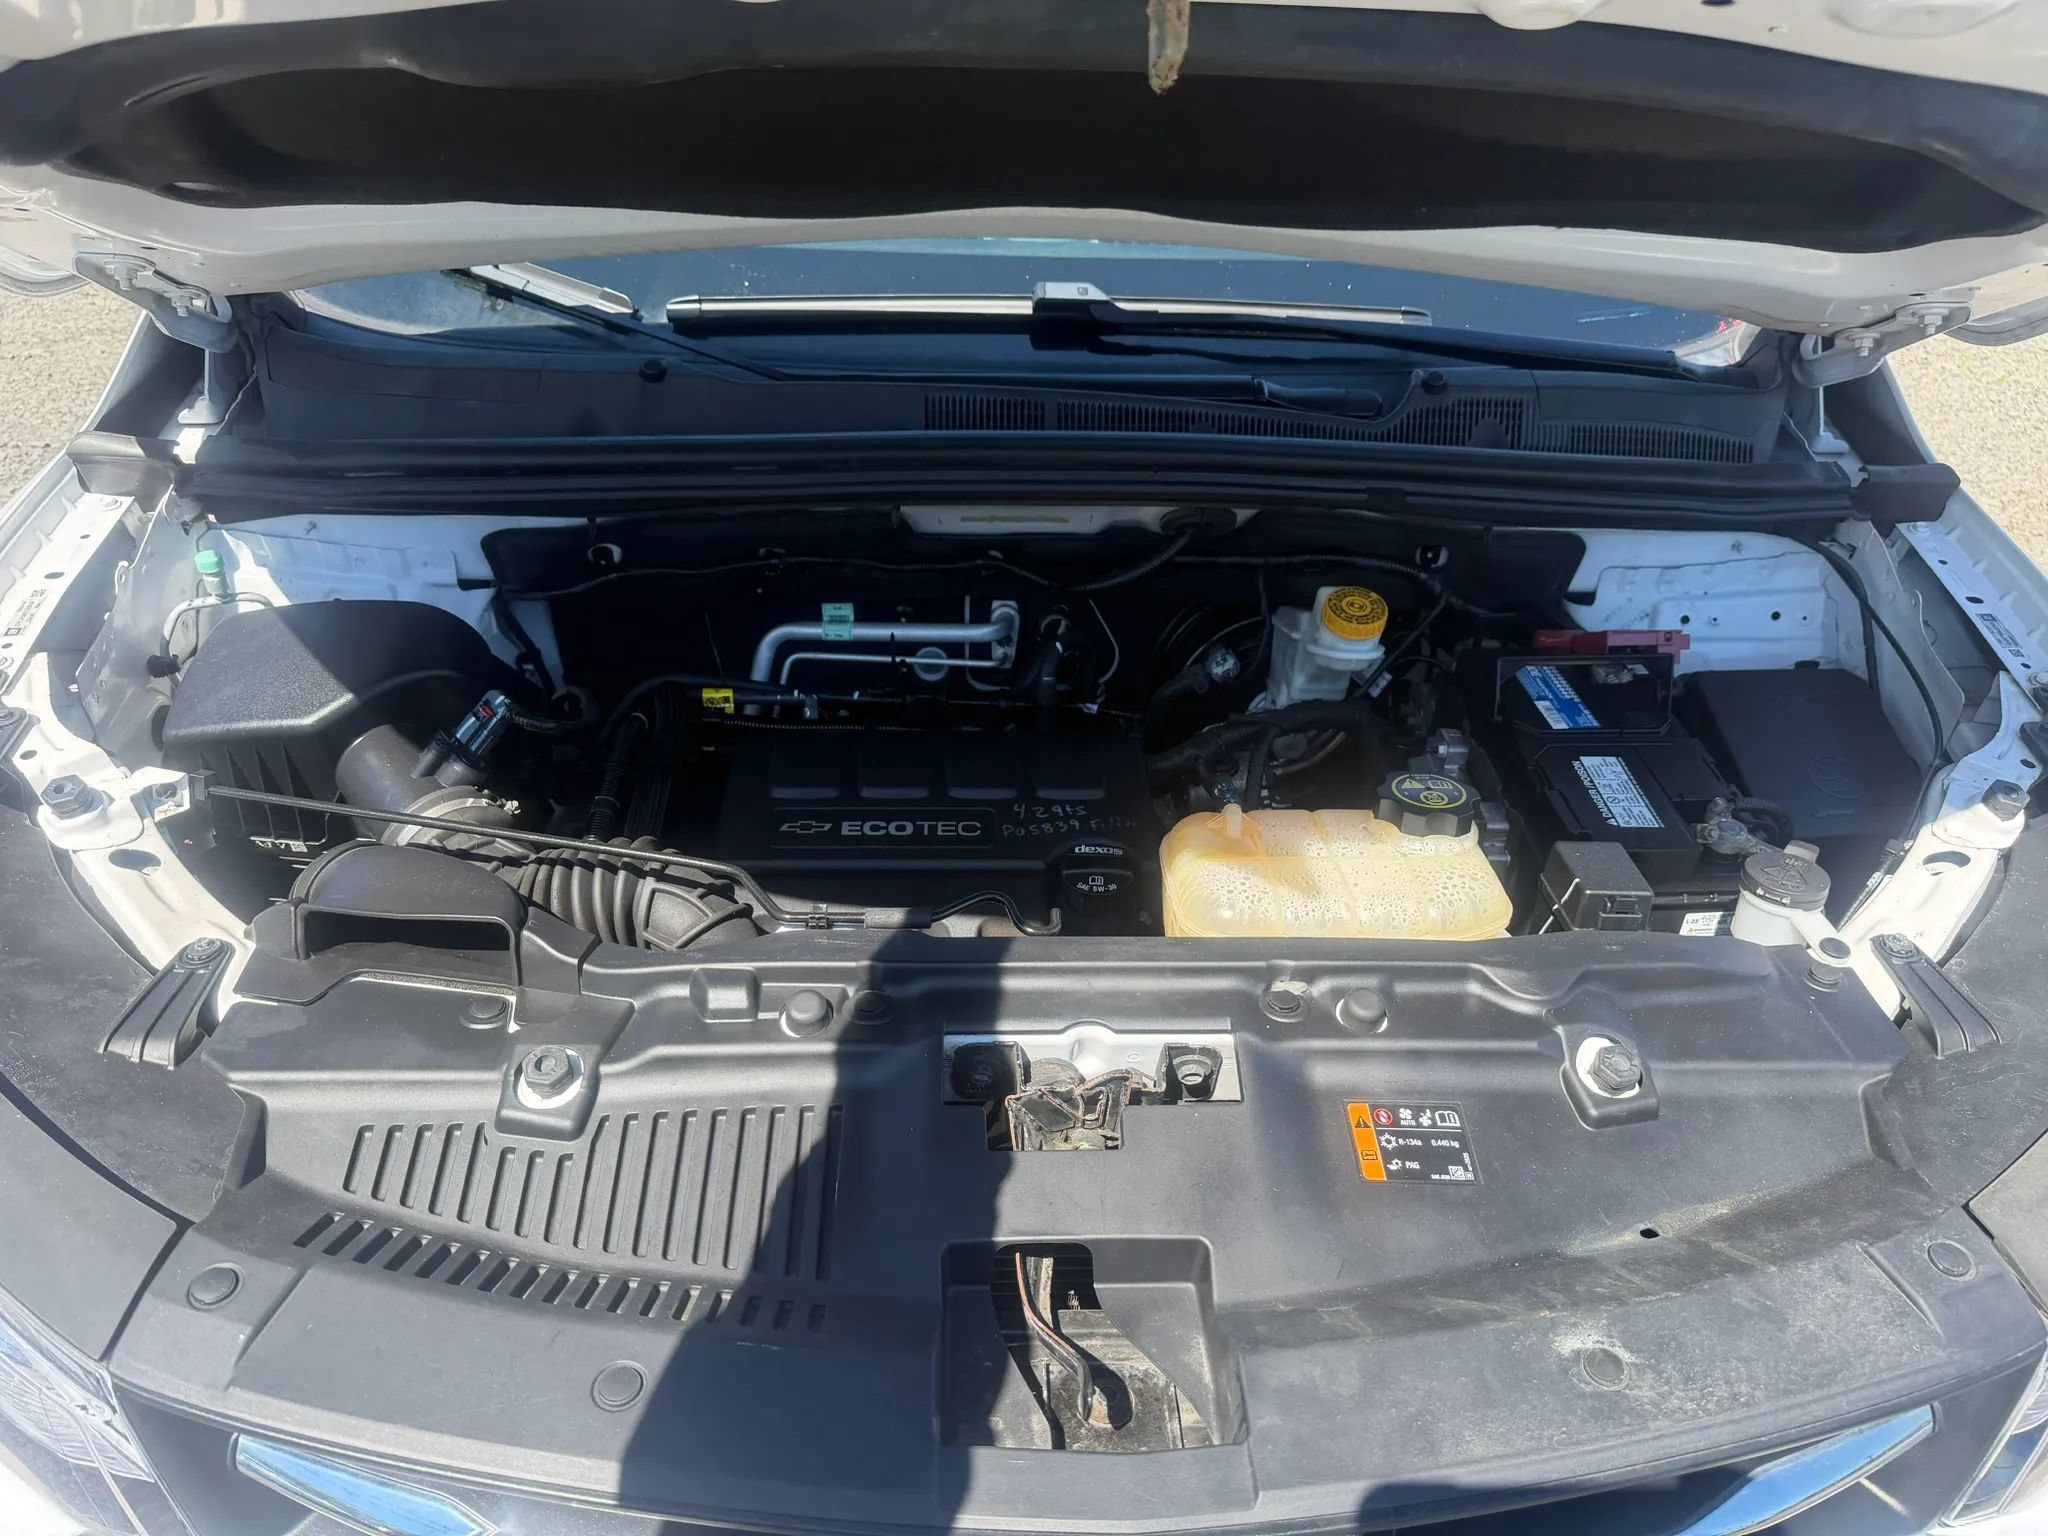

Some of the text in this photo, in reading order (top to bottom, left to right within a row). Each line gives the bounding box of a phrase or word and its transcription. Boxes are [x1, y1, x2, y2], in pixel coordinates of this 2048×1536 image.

[841, 821, 982, 836] ECOTEC
[1074, 844, 1124, 856] dexos
[1076, 881, 1118, 893] SAE 5W-30
[1398, 1138, 1460, 1149] R-134a 0.440 kg
[1404, 1160, 1421, 1169] PAG
